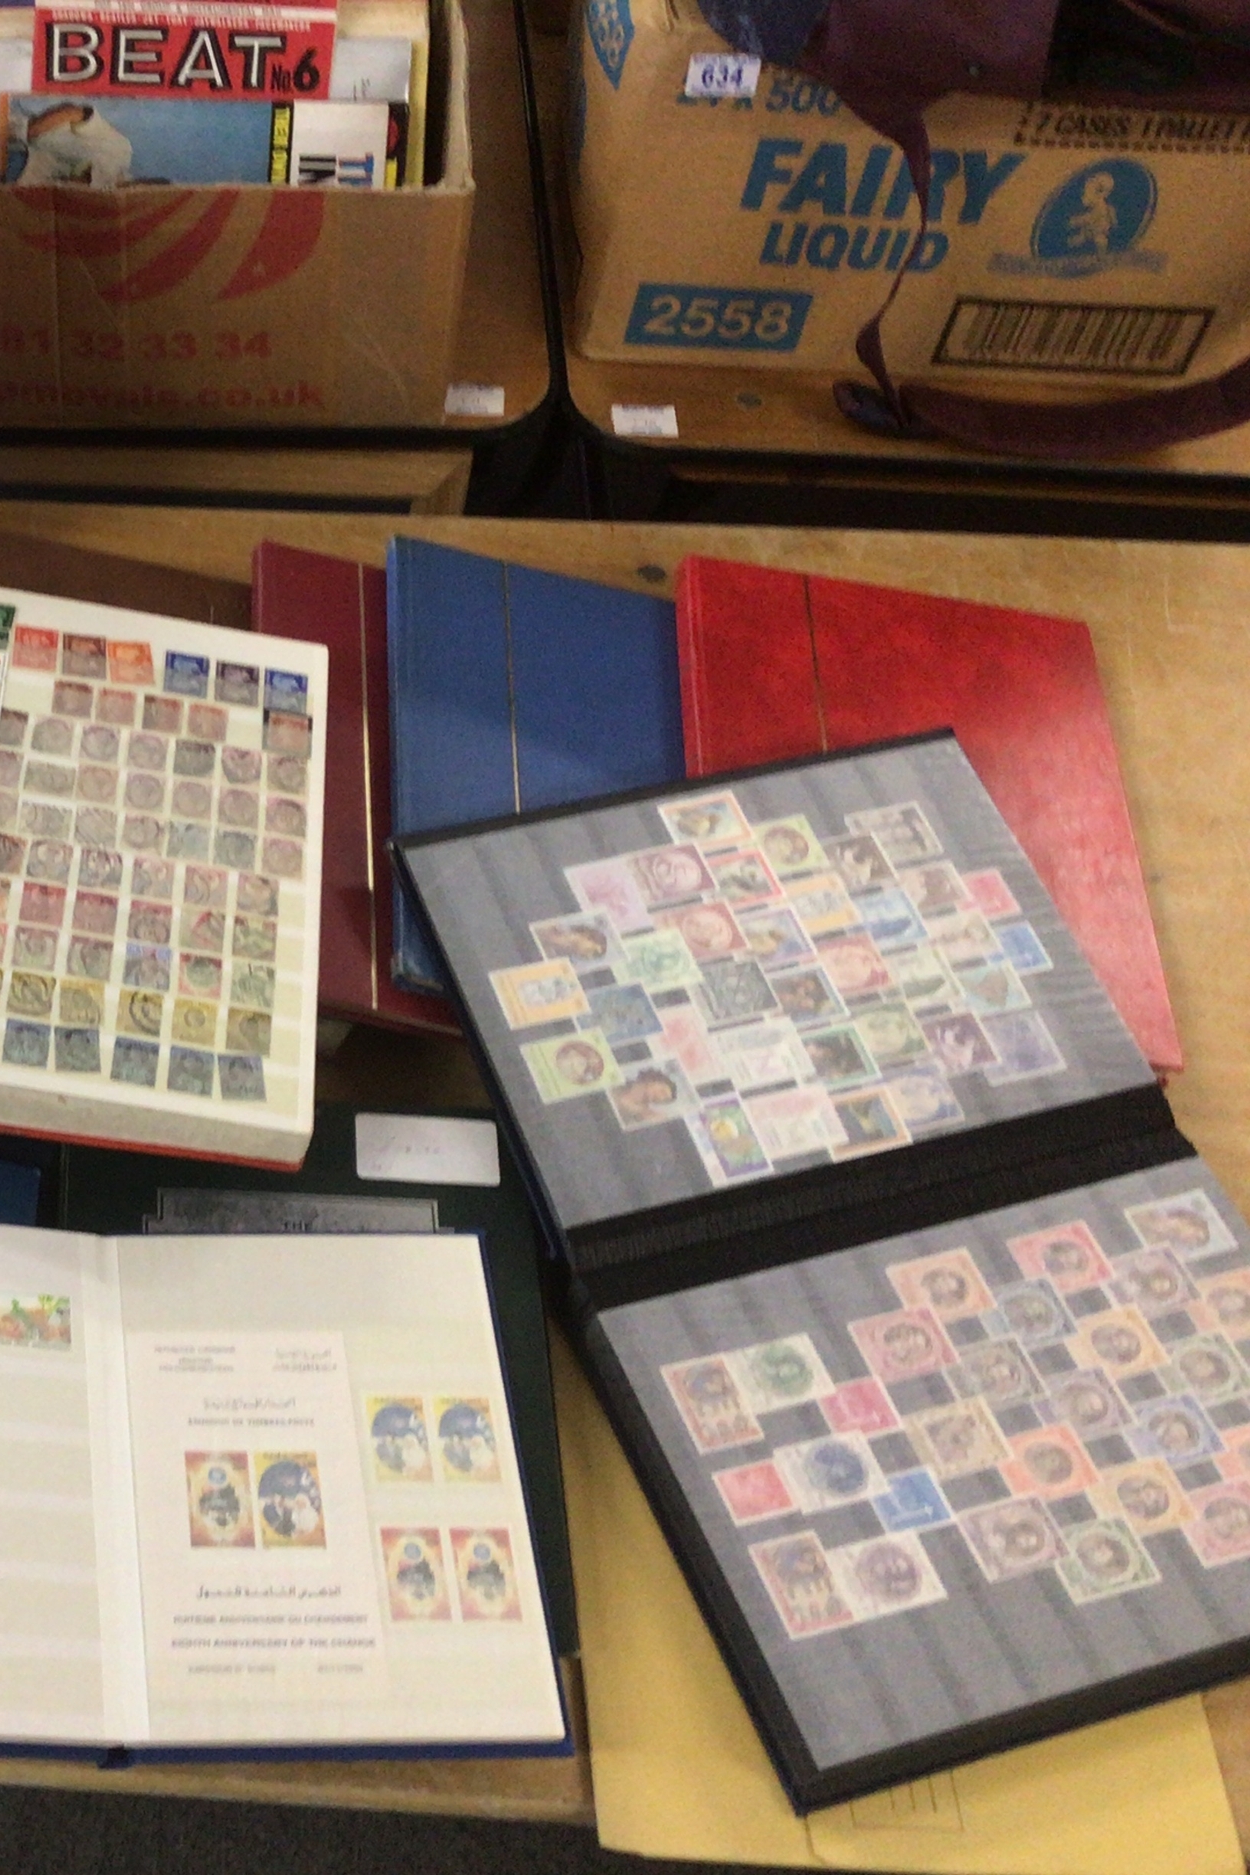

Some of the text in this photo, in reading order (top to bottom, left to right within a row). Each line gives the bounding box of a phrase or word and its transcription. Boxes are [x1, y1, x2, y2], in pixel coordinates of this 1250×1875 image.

[46, 22, 286, 92] BEAT
[701, 64, 745, 88] 634
[740, 137, 1028, 226] FAIRY
[759, 222, 949, 273] LIQUID
[642, 293, 794, 343] 2558
[143, 331, 197, 359] 33
[215, 331, 271, 360] 34
